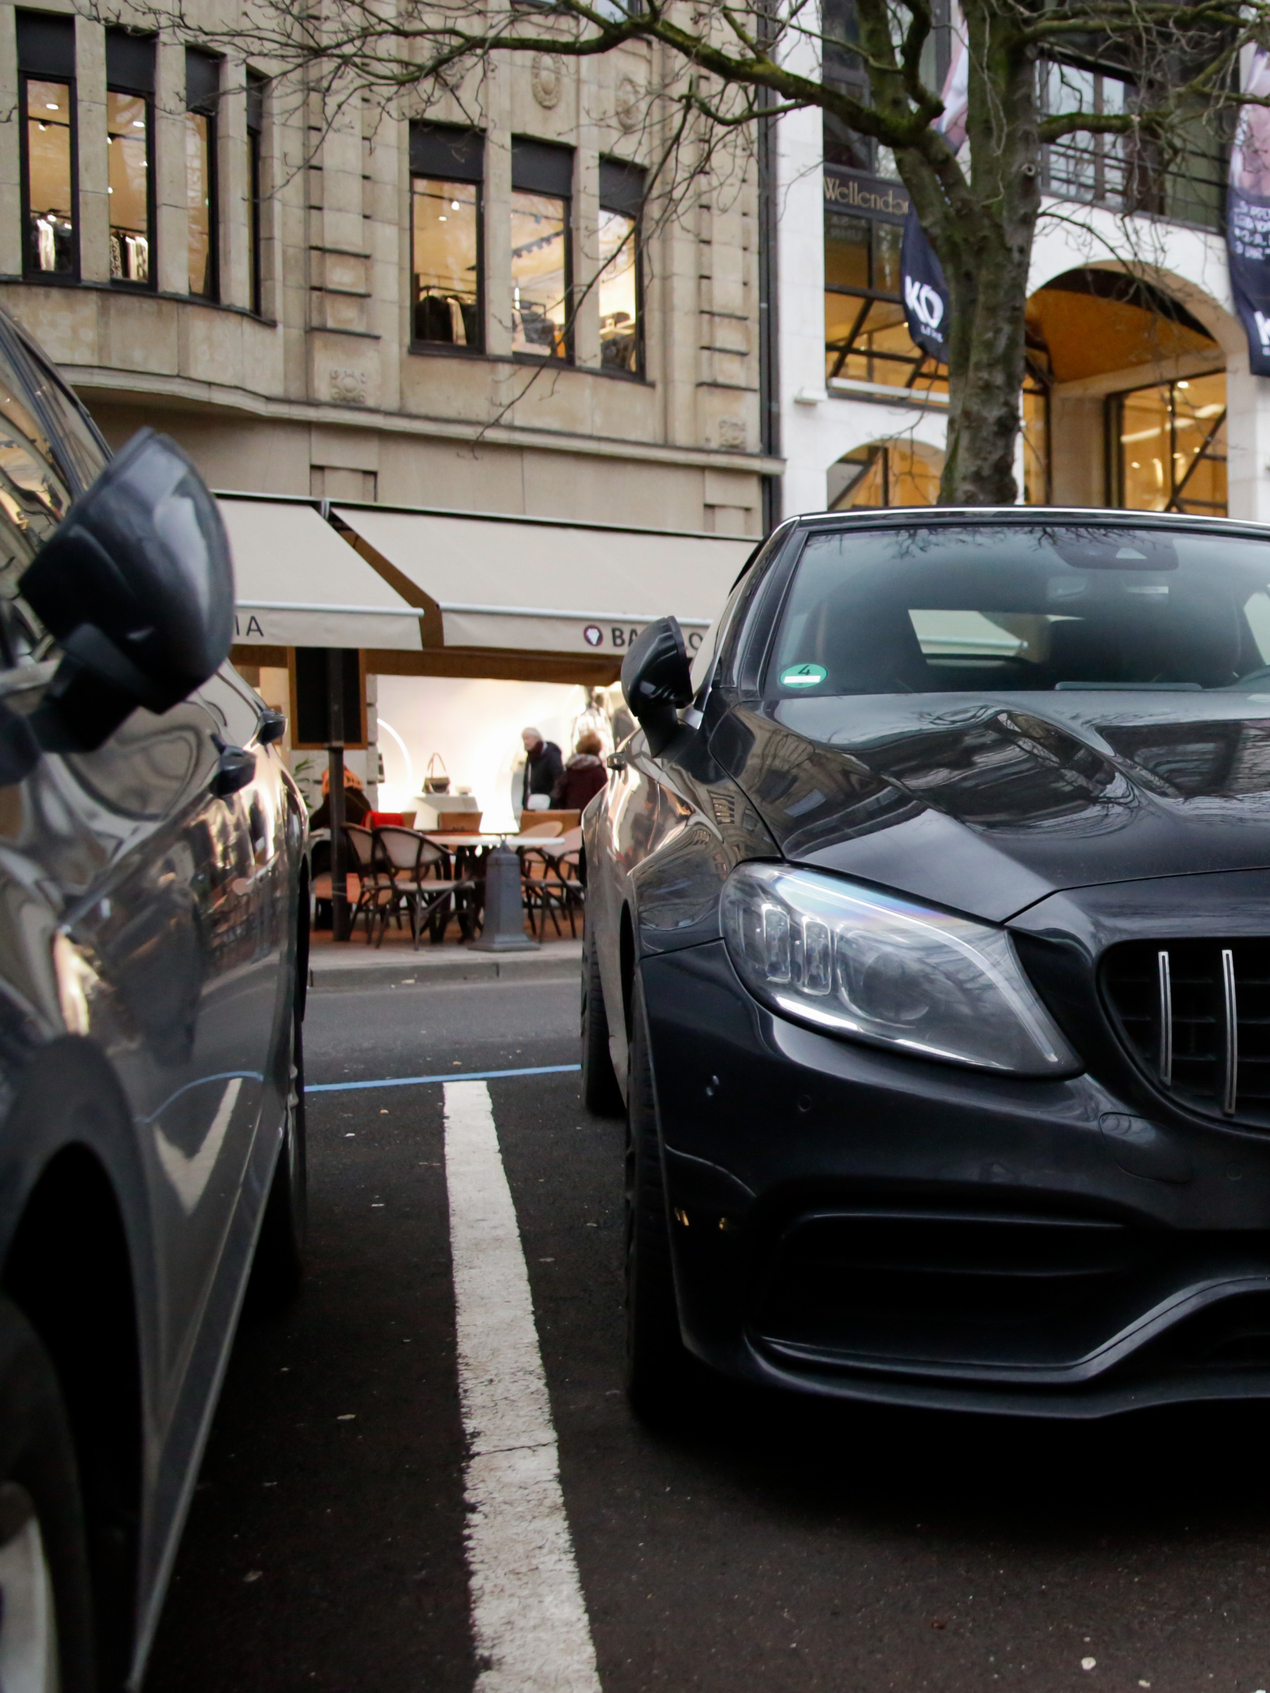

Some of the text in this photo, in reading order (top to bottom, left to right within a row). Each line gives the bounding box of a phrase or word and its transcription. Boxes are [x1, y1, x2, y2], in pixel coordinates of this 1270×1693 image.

[824, 177, 909, 215] Wellendor
[235, 615, 264, 637] IA
[798, 664, 811, 676] 4
